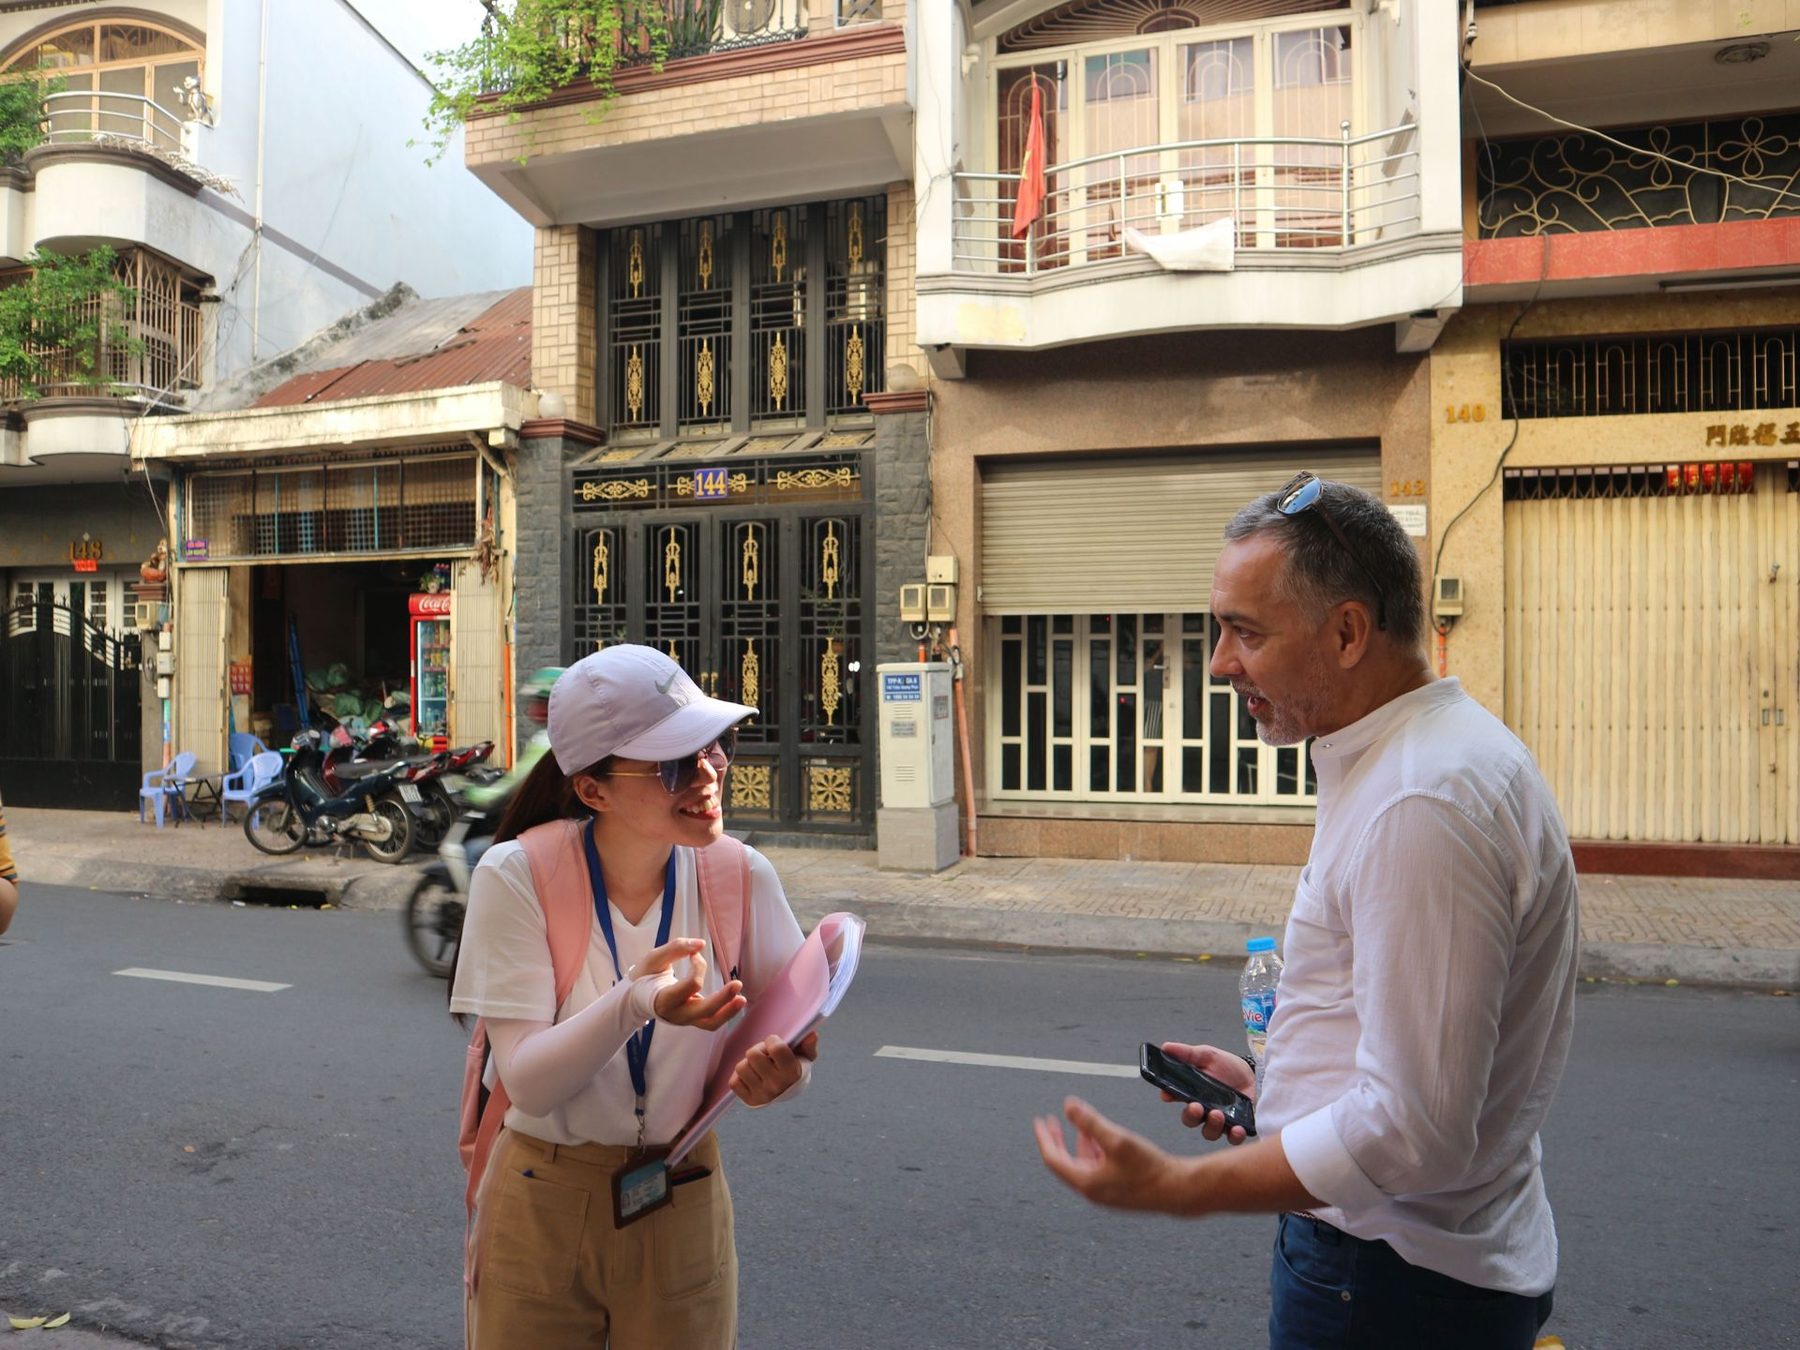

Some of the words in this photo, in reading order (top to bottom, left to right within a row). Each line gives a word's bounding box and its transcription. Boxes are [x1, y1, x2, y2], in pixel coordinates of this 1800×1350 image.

[1445, 403, 1486, 424] 140
[696, 471, 726, 496] 144
[1391, 480, 1425, 497] 142
[69, 540, 103, 561] 148
